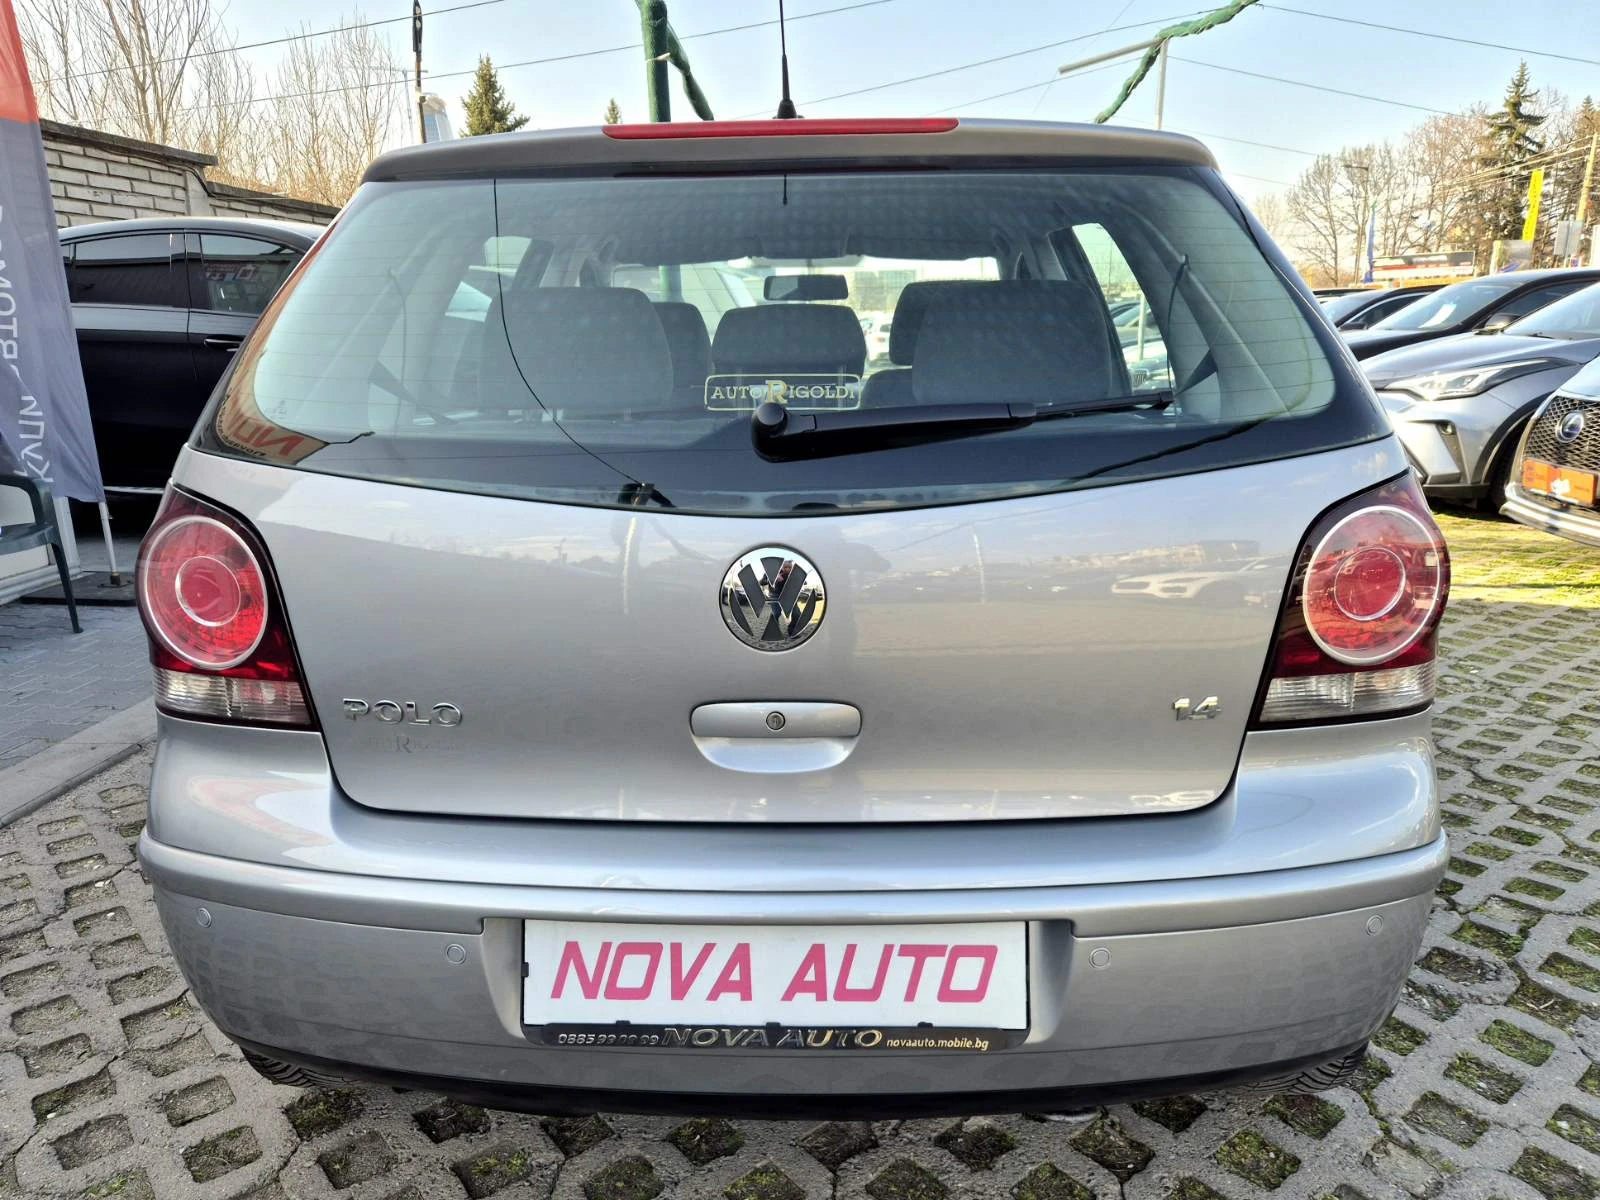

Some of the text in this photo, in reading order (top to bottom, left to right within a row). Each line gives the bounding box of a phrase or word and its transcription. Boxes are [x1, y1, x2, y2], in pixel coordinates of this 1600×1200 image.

[719, 544, 827, 652] VW
[342, 697, 463, 728] POLO
[550, 940, 999, 1003] NOVA AUTO
[557, 1033, 596, 1045] 0885
[661, 1027, 883, 1048] NOVA AUTO
[886, 1037, 989, 1051] novaauto.mobile.bg
